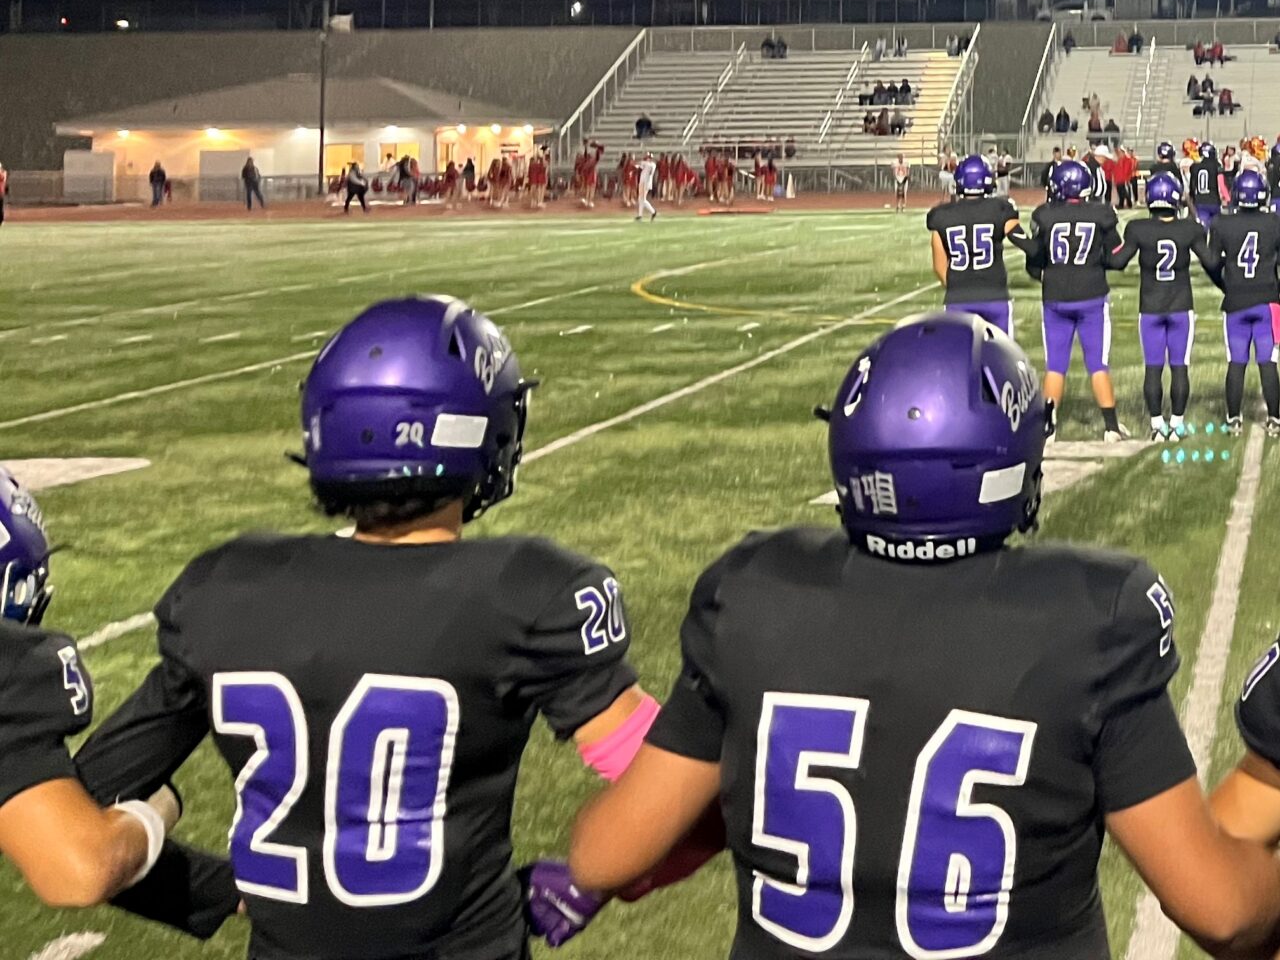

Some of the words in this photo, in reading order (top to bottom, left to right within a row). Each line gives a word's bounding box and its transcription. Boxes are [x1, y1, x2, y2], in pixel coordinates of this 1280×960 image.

[946, 224, 995, 271] 55
[1050, 222, 1096, 265] 67
[1156, 240, 1177, 281] 2
[1238, 231, 1259, 278] 4
[395, 422, 424, 447] 20
[866, 534, 976, 560] Riddell
[574, 577, 626, 655] 20
[212, 671, 459, 906] 20
[752, 691, 1038, 960] 56
